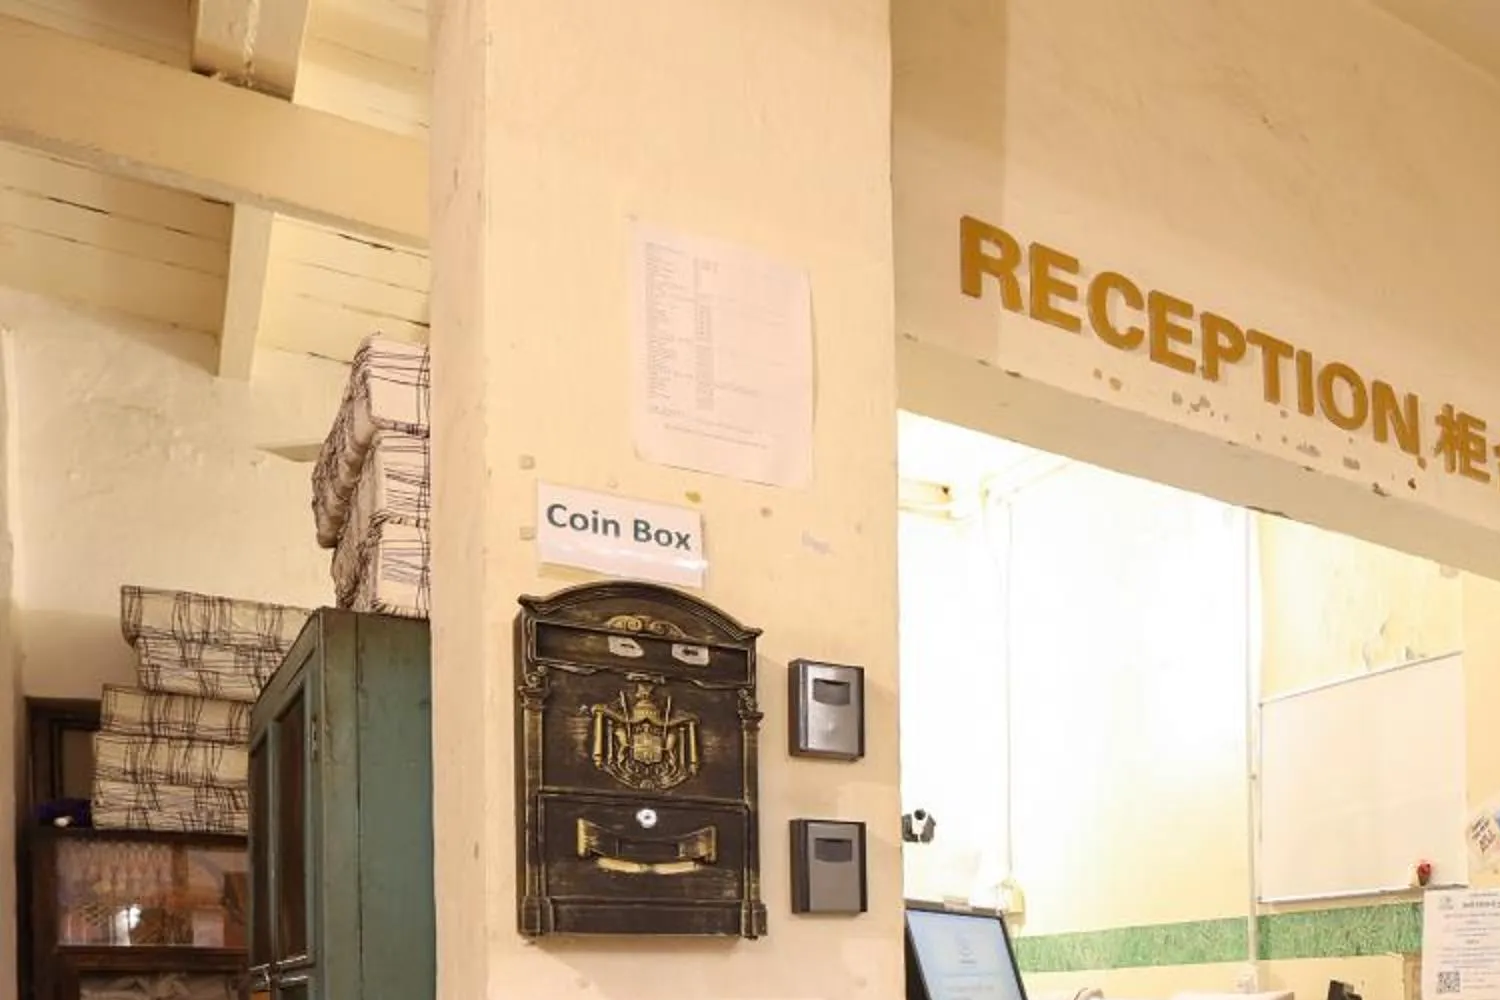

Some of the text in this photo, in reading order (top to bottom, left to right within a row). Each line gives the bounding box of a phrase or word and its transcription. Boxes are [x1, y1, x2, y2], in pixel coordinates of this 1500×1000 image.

[960, 215, 1421, 455] RECEPTION
[546, 502, 692, 551] Coin Box
